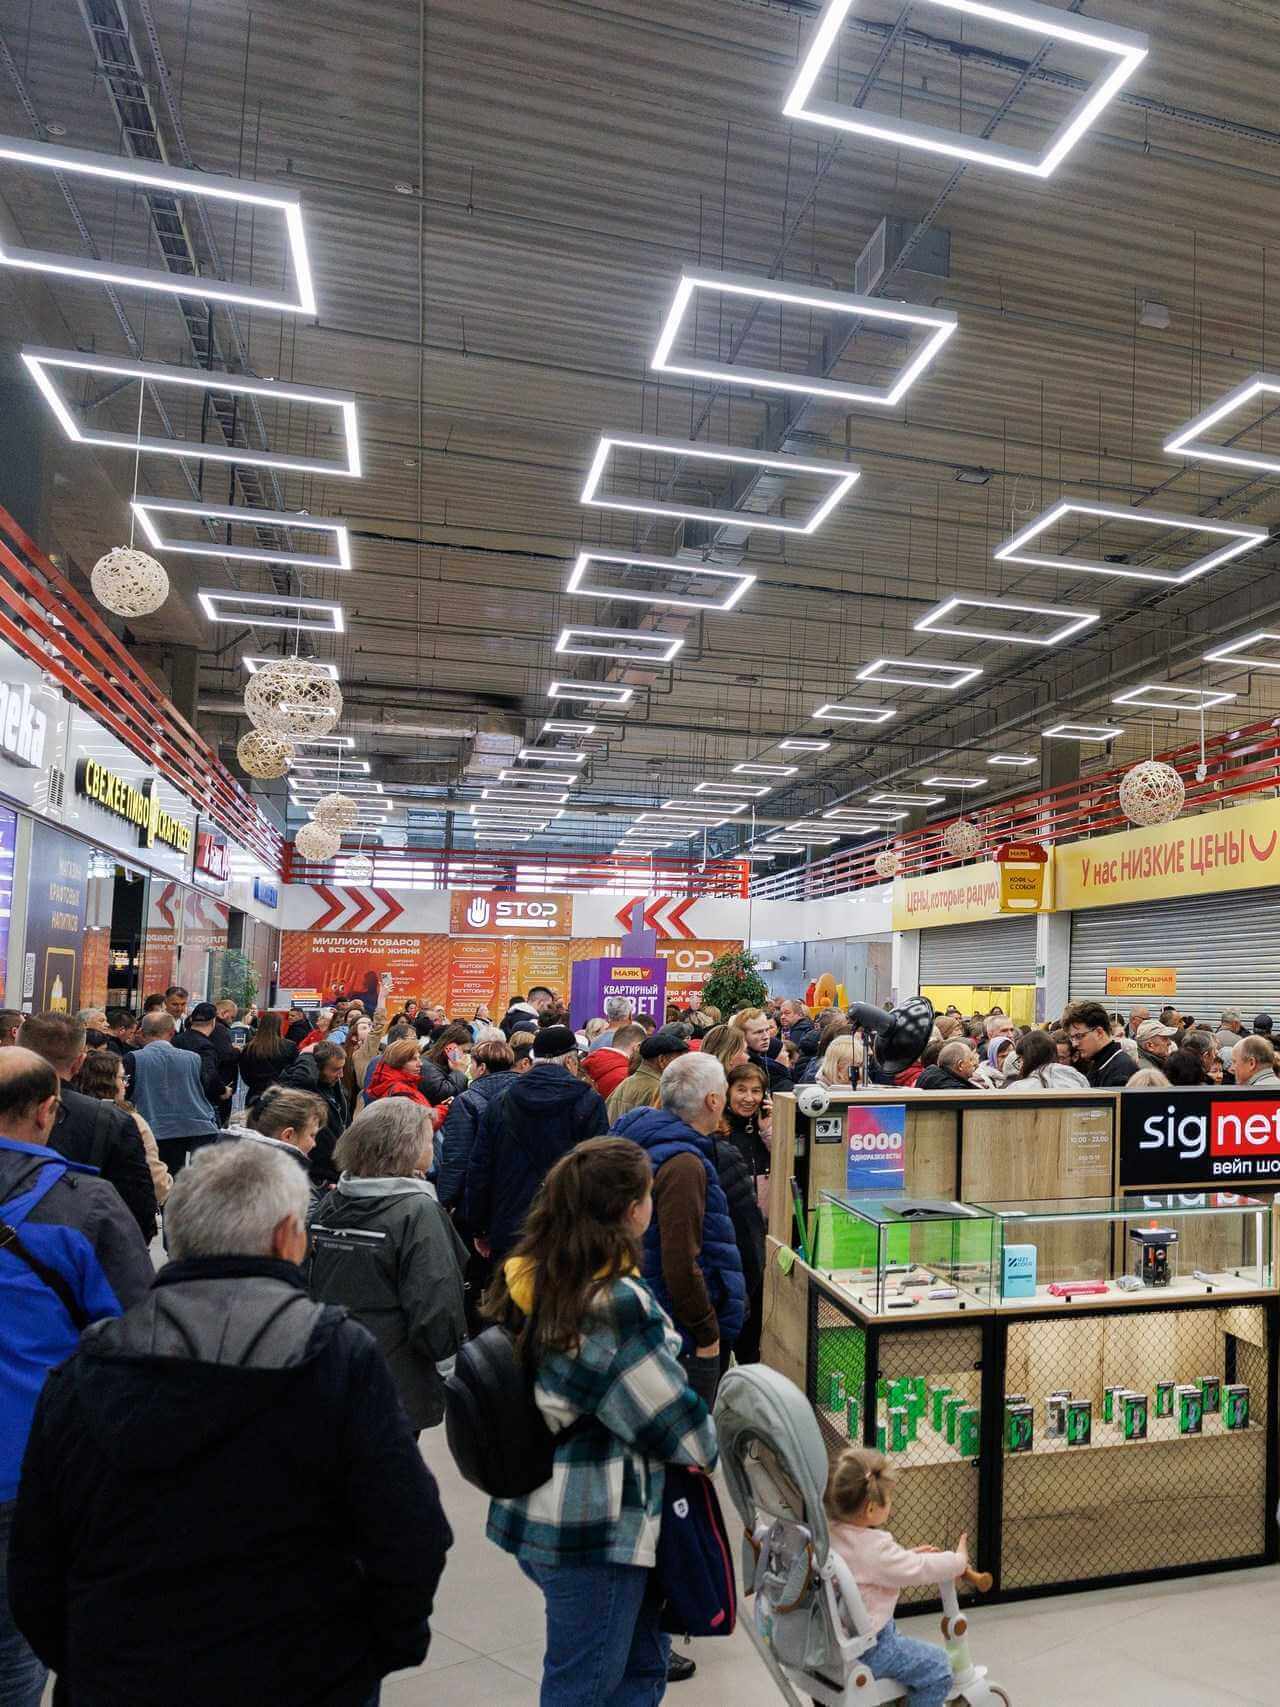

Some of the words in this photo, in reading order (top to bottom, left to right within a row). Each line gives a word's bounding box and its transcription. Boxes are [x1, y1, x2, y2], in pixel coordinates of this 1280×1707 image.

[85, 758, 127, 814] СВЕЖЕЕ
[126, 788, 151, 829] ПИВО
[1081, 858, 1091, 887] У
[1093, 858, 1118, 886] нас
[1121, 839, 1185, 882] НИЗКИЕ
[1190, 828, 1246, 877] ЦЕНЫ
[930, 888, 965, 911] которые
[495, 901, 558, 917] STOP
[312, 937, 368, 946] МИЛЛИОН
[372, 938, 421, 947] ТОВАРОВ
[613, 969, 640, 977] МАЯК
[1110, 976, 1173, 984] БЕСПРОИГРЫШНАЯ
[603, 984, 658, 995] КВАРТИРНЫЙ
[603, 996, 658, 1015] ВЕТ
[850, 1132, 902, 1151] 6000
[1213, 1159, 1251, 1175] вейп
